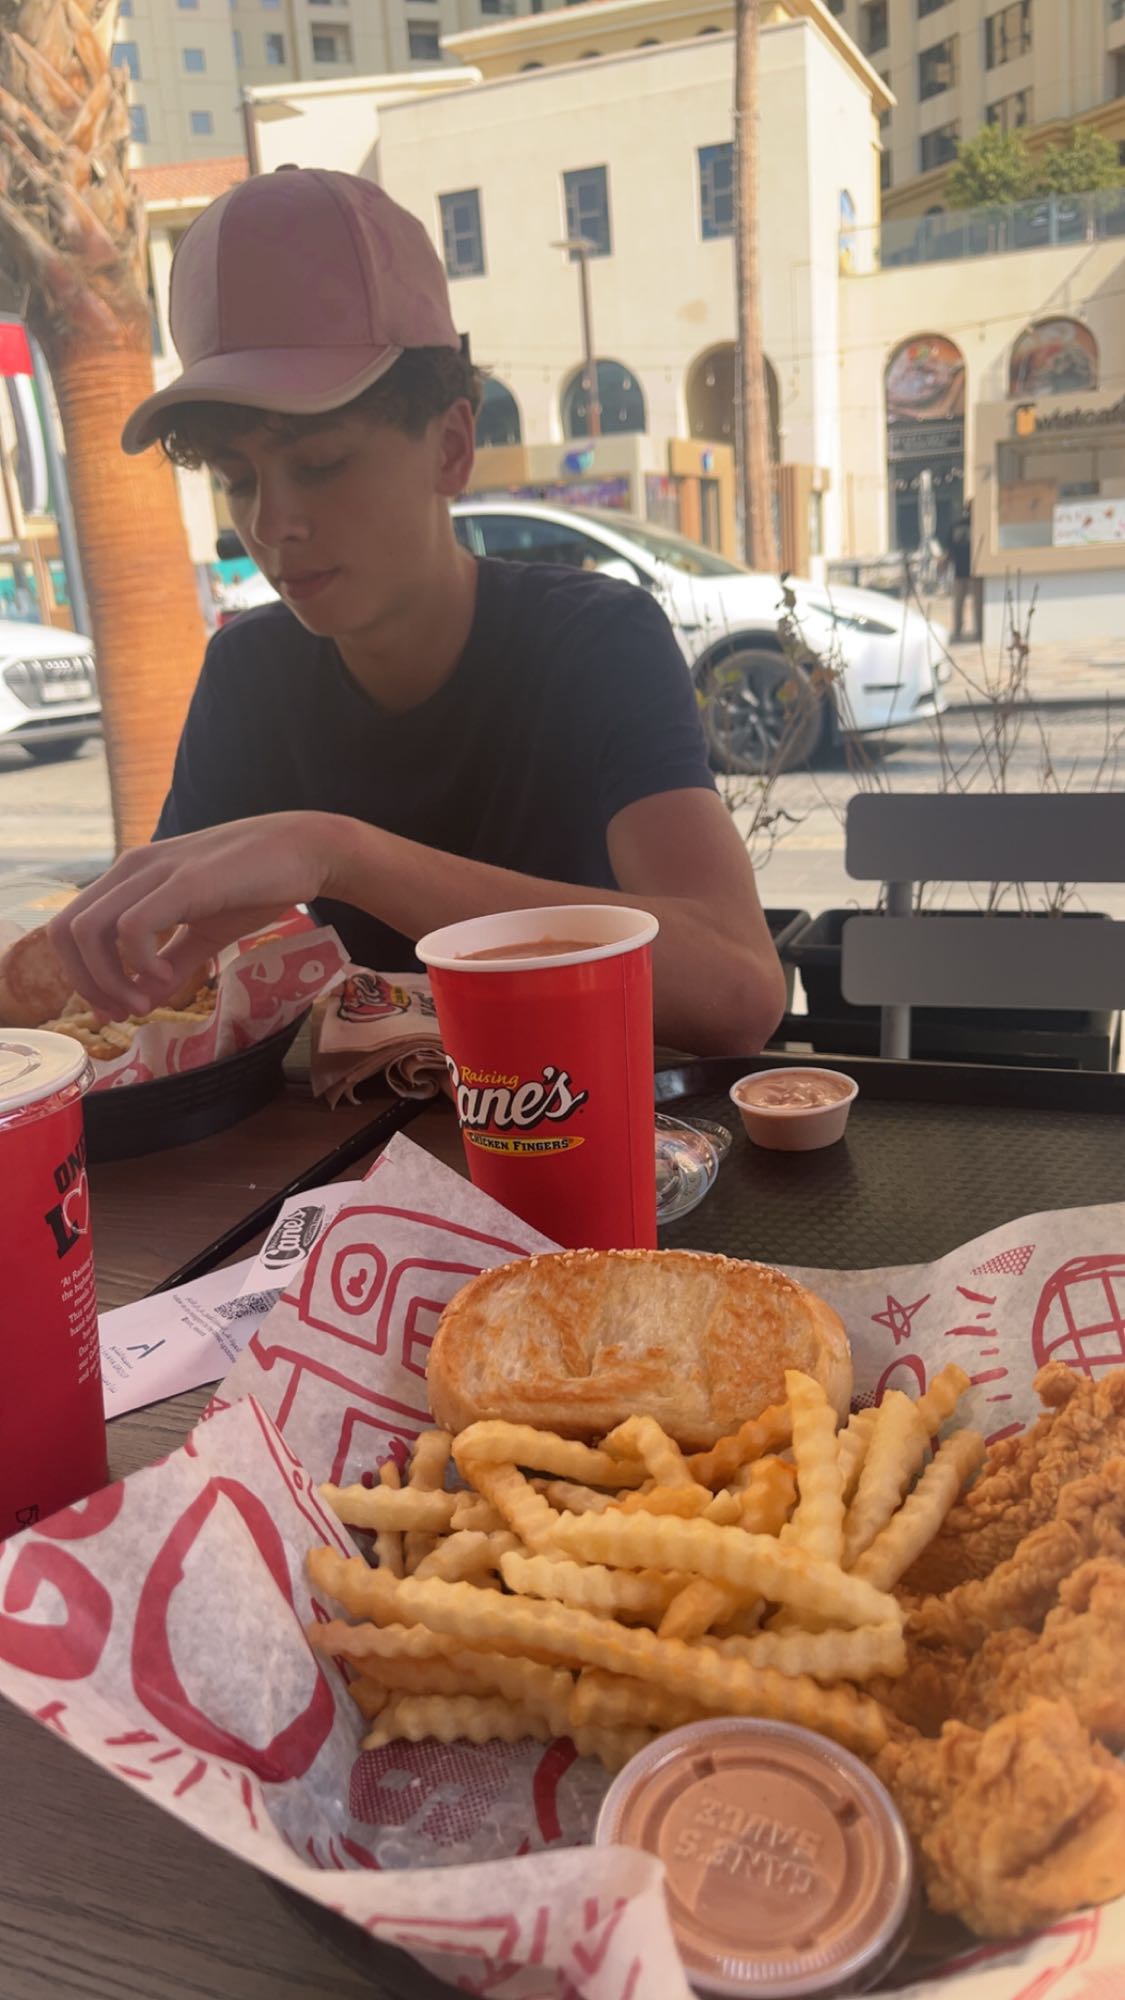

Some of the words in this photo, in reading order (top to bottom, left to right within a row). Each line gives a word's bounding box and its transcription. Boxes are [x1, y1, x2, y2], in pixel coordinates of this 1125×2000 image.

[460, 1066, 519, 1089] Raising
[469, 1133, 510, 1150] CHICKEN
[513, 1139, 570, 1151] FINGERS
[694, 1797, 822, 1861] SAUCE
